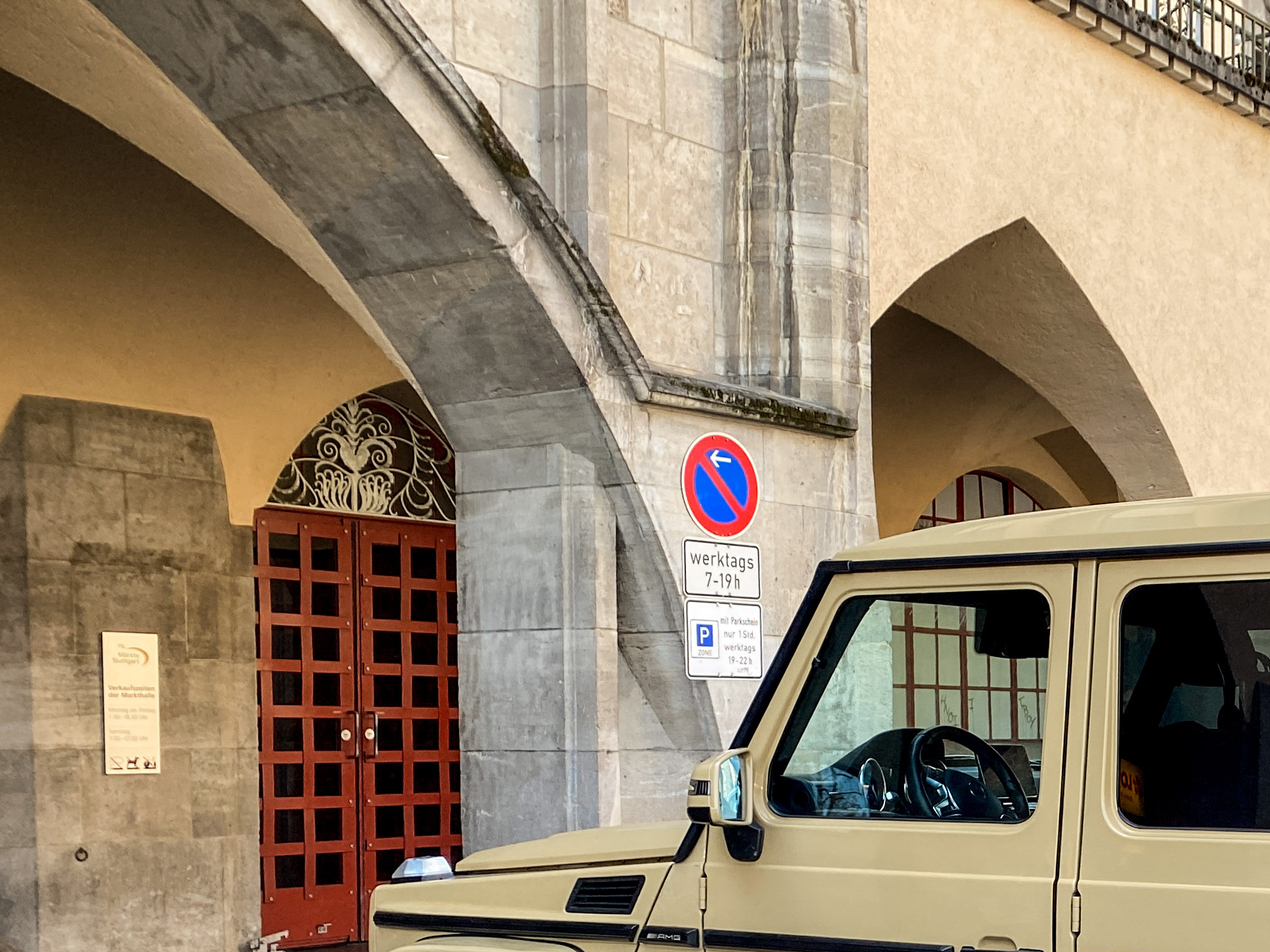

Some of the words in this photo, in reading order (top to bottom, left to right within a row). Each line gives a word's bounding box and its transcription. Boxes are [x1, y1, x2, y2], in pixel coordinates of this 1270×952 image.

[690, 551, 754, 573] werktags
[720, 616, 729, 625] mit
[731, 616, 758, 626] Parkschein
[724, 643, 756, 653] werktags
[112, 657, 139, 665] Stuttgart
